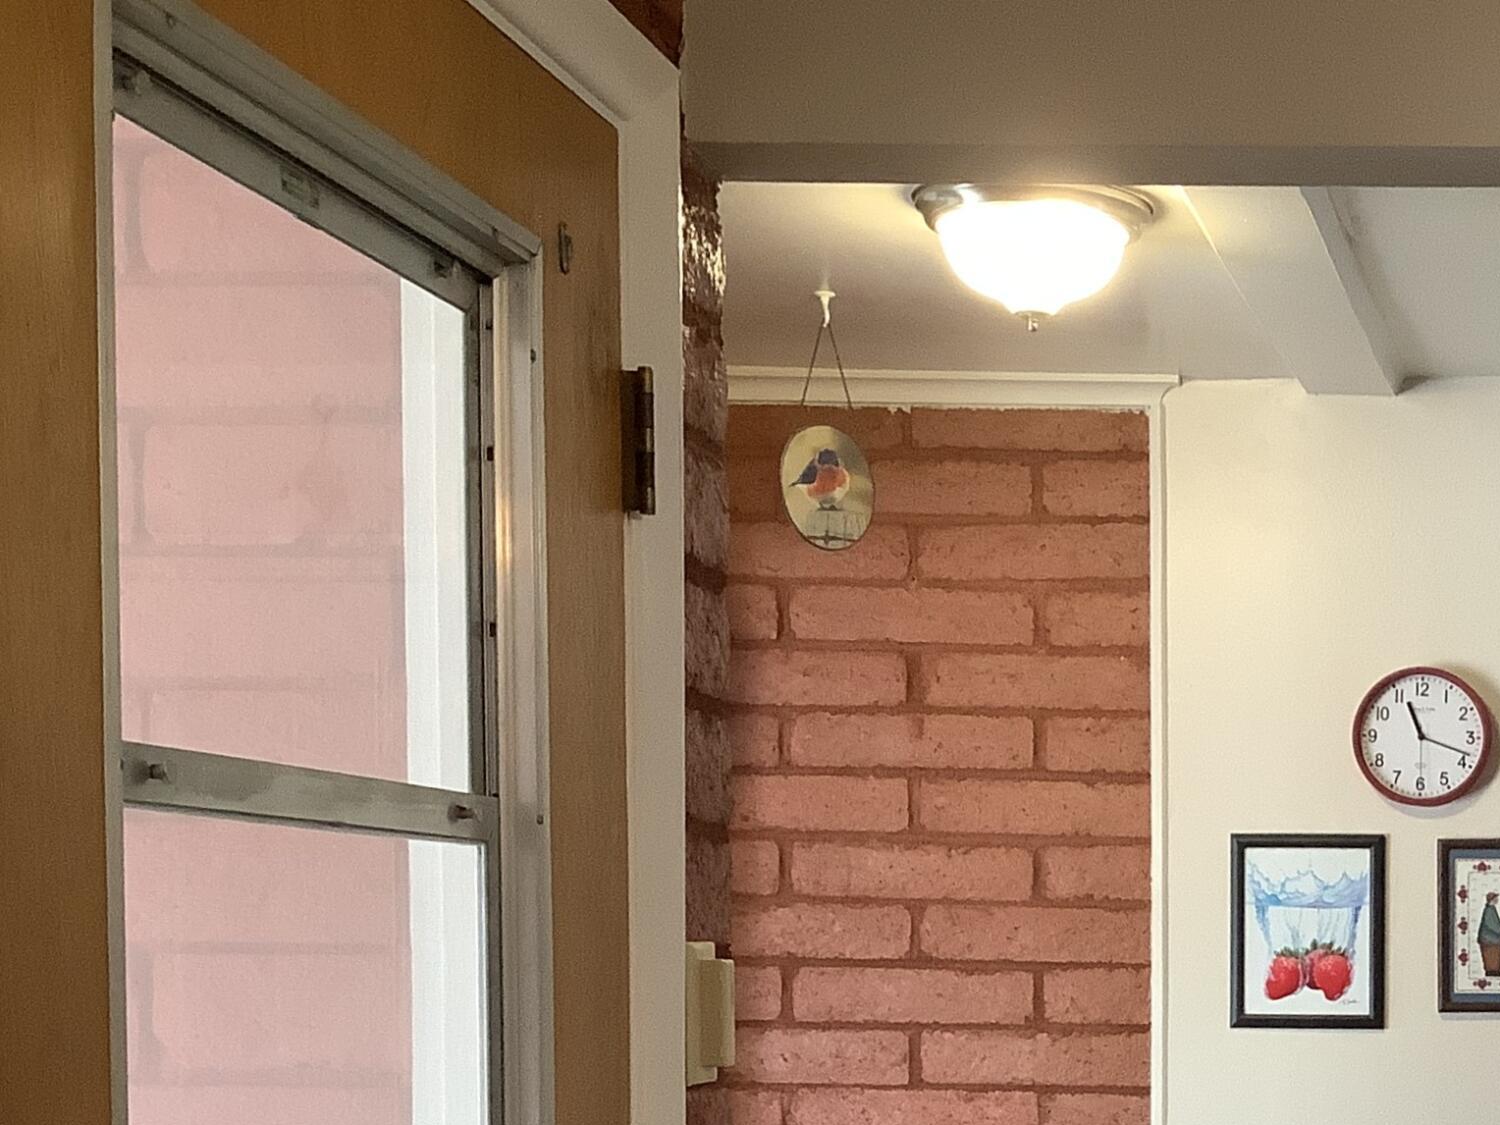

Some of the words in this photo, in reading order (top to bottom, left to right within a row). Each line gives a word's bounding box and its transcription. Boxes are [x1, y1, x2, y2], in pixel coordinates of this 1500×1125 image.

[1395, 689, 1404, 704] 11
[1415, 682, 1430, 697] 12
[1376, 706, 1390, 721] 10
[1458, 706, 1468, 721] 2
[1367, 729, 1377, 743] 9
[1465, 730, 1475, 745] 3
[1374, 753, 1384, 767] 8
[1457, 755, 1467, 769] 4
[1393, 770, 1402, 784] 7
[1415, 777, 1425, 791] 6
[1439, 772, 1449, 786] 5
